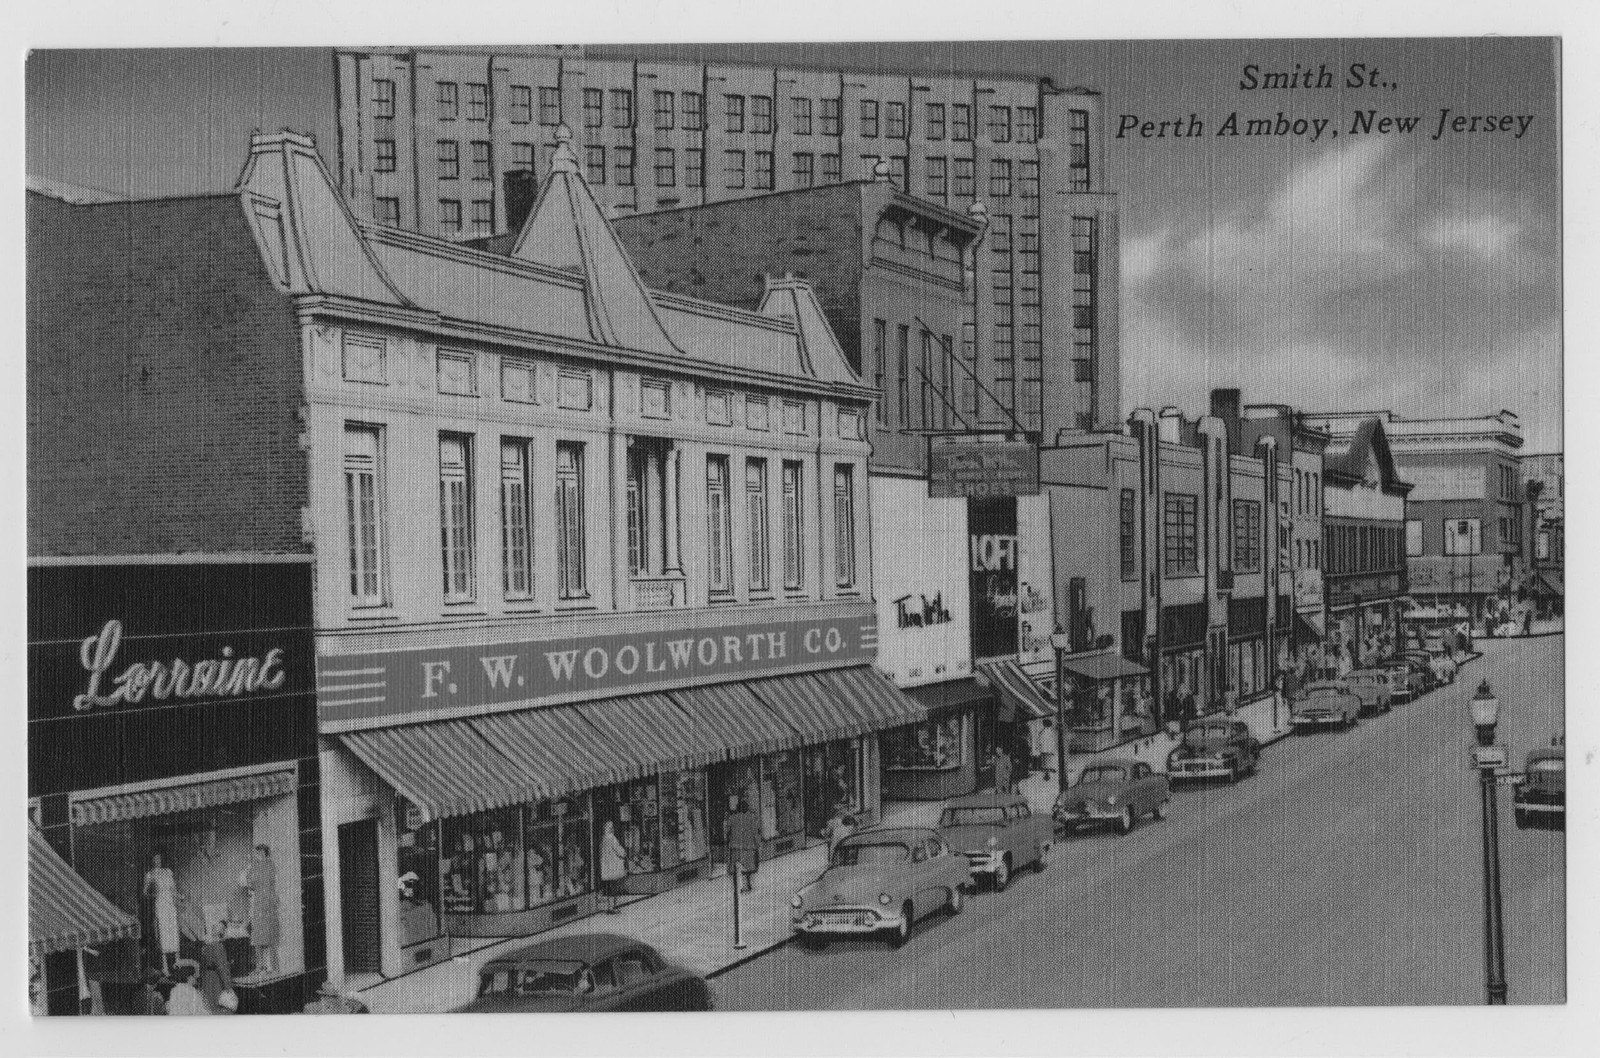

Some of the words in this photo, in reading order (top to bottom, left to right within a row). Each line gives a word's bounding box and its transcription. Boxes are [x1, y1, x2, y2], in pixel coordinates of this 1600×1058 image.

[970, 533, 1019, 572] LOFT
[72, 618, 286, 711] Lorraine
[420, 660, 458, 699] F.
[480, 654, 526, 689] W.
[543, 630, 788, 682] WOOLWORTH
[804, 626, 848, 654] CO.
